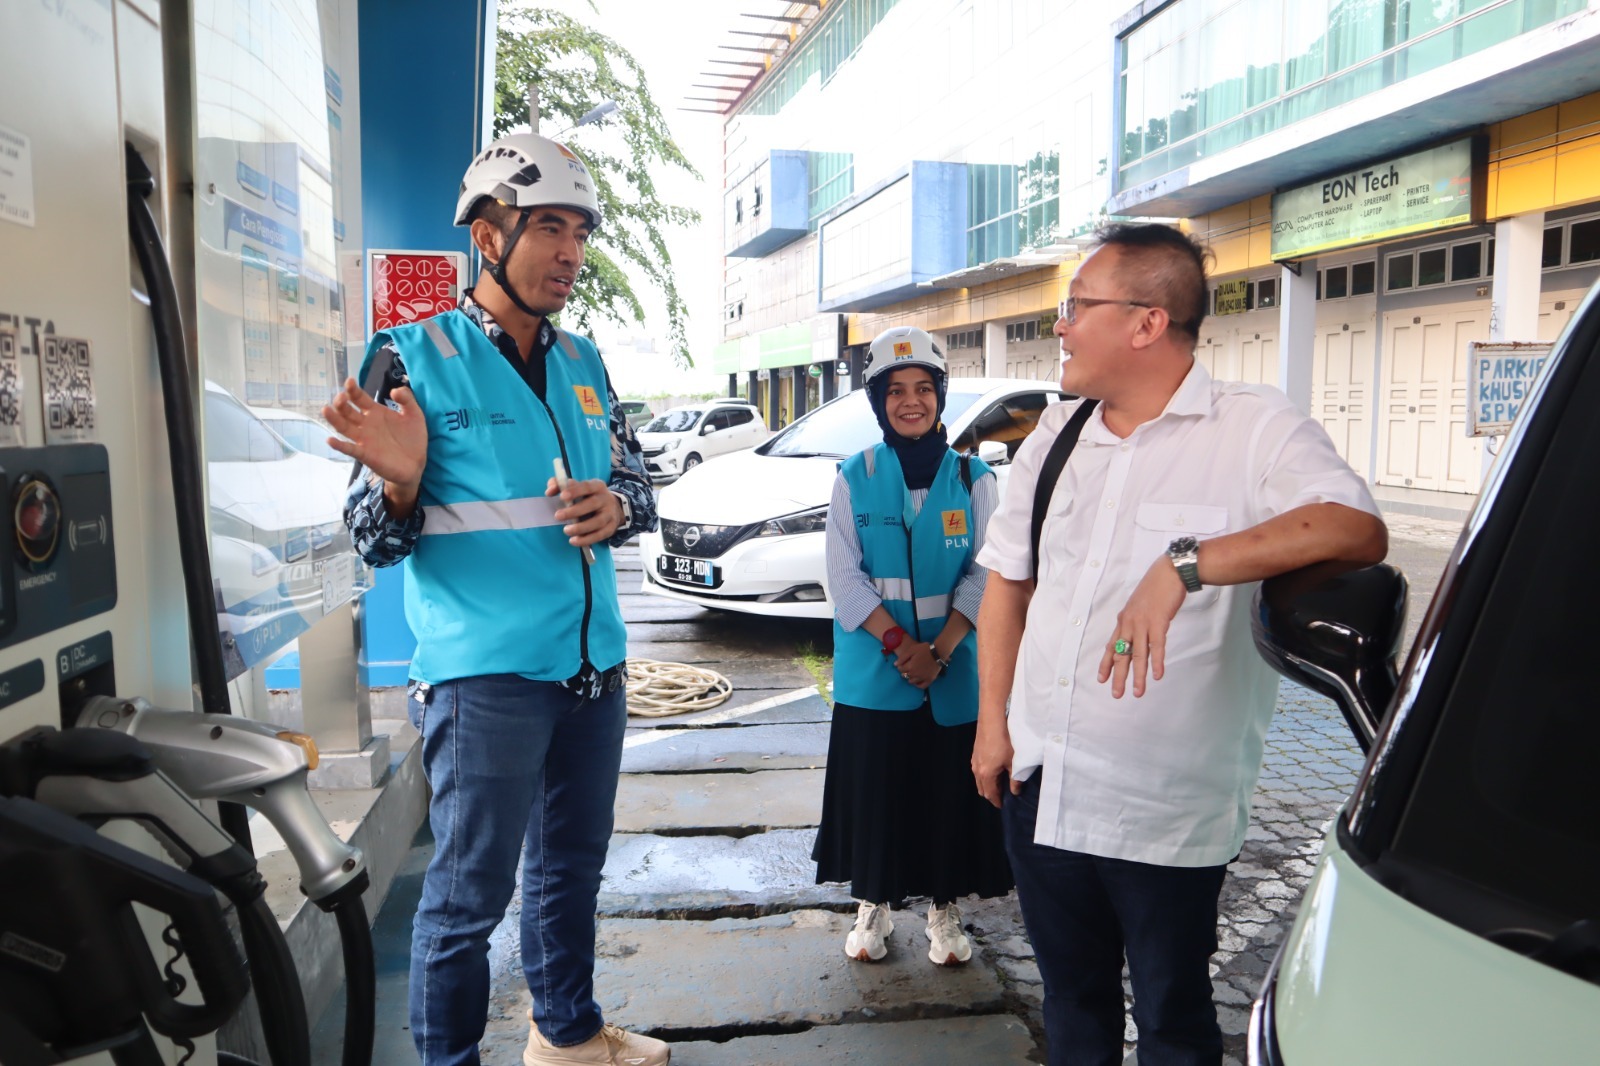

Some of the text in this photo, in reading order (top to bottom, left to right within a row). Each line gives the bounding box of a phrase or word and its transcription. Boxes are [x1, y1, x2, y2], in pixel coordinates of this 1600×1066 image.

[568, 162, 586, 174] PLN
[1322, 165, 1399, 204] EON Tech
[1406, 184, 1430, 196] PRINTER
[1363, 193, 1392, 207] SPAREPART
[1406, 195, 1429, 208] SERVICE
[1297, 203, 1353, 224] COMPUTER HARDWARE
[1363, 206, 1382, 218] LAPTOP
[241, 213, 257, 230] Cara
[1296, 218, 1335, 233] COMPUTER ACC
[586, 418, 608, 431] PLN
[945, 537, 969, 549] PLN
[661, 556, 711, 577] B 123 MDN
[20, 572, 57, 590] EMERGENCY
[263, 621, 282, 643] PLN
[74, 645, 86, 660] DC
[60, 655, 69, 674] B
